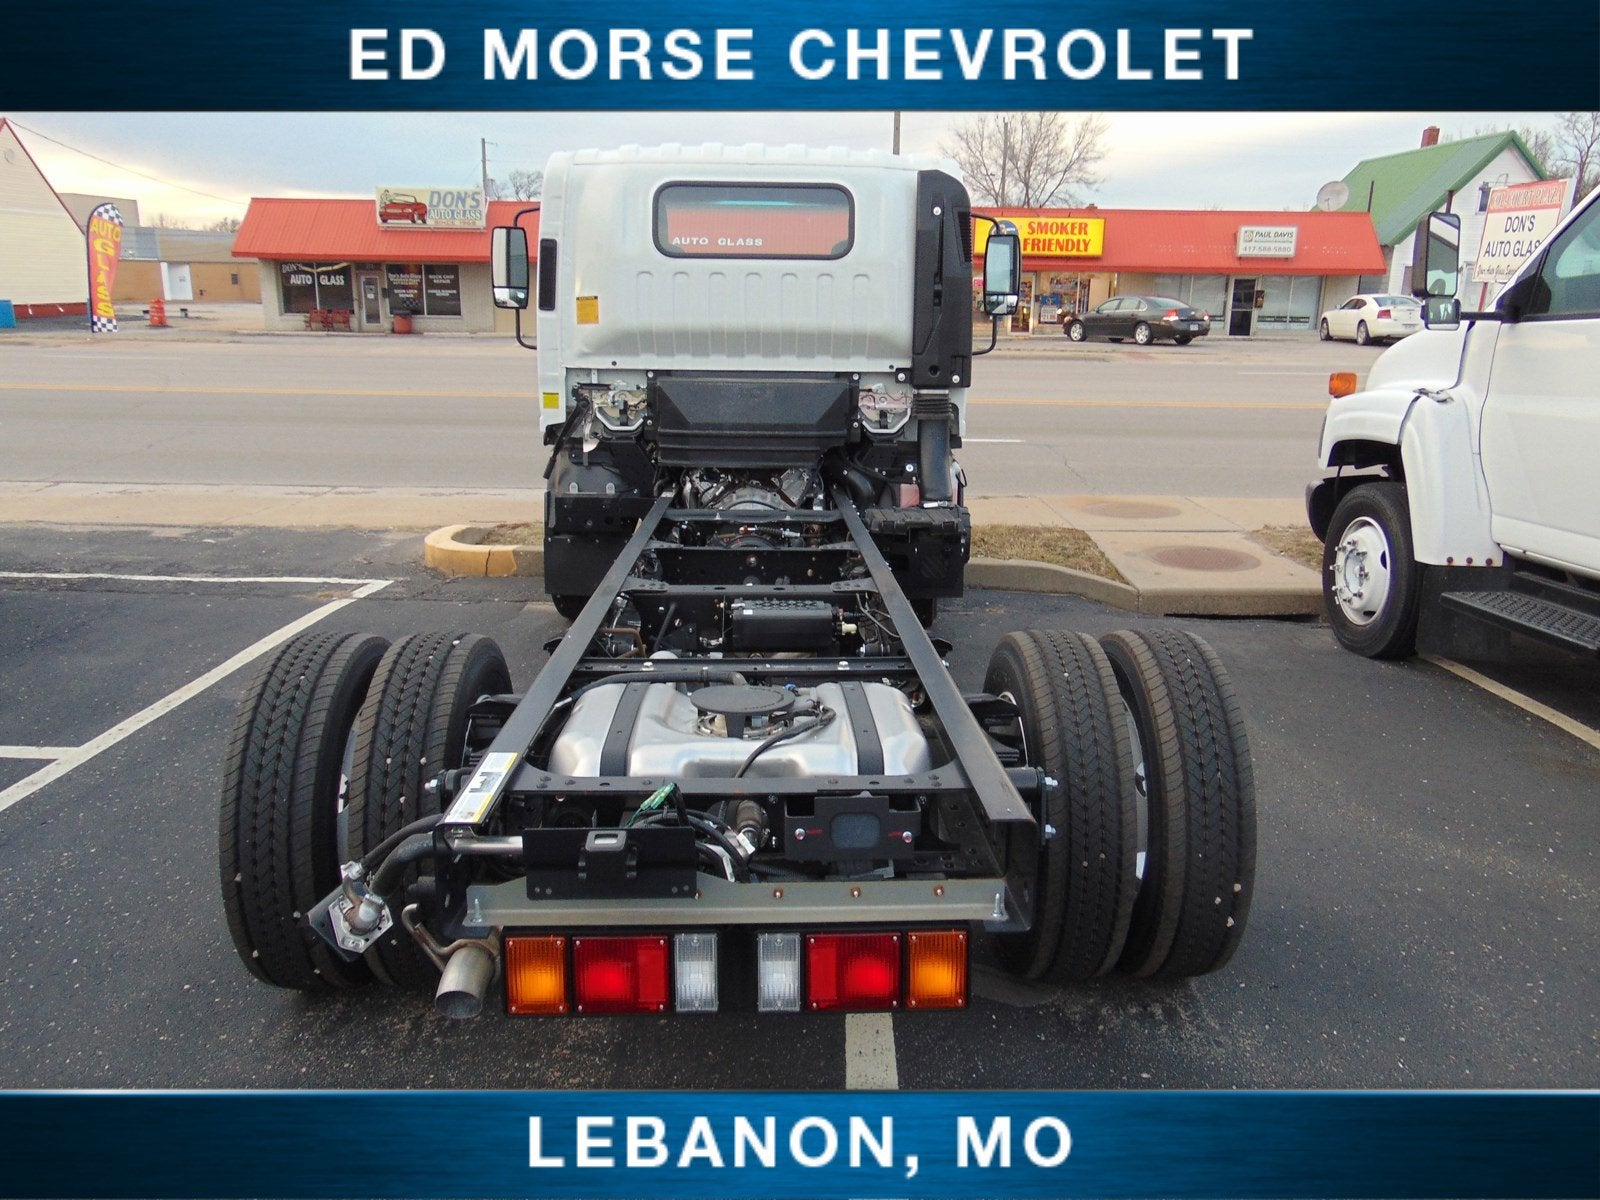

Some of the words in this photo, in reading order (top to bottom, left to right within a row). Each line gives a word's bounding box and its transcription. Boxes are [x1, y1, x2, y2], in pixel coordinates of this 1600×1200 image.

[429, 191, 480, 208] DON'S
[429, 209, 452, 220] AUTO
[455, 209, 482, 220] GLASS
[90, 218, 121, 241] AUTO
[1028, 221, 1088, 235] SMOKER
[1504, 215, 1536, 233] DON'S
[672, 237, 709, 245] AUTO
[718, 237, 763, 246] GLASS
[1023, 238, 1091, 253] FRIENDLY
[1484, 240, 1511, 257] AUTO
[1513, 239, 1541, 257] GLAS
[93, 237, 115, 317] GLASS
[290, 274, 312, 285] AUTO
[319, 275, 345, 285] GLASS
